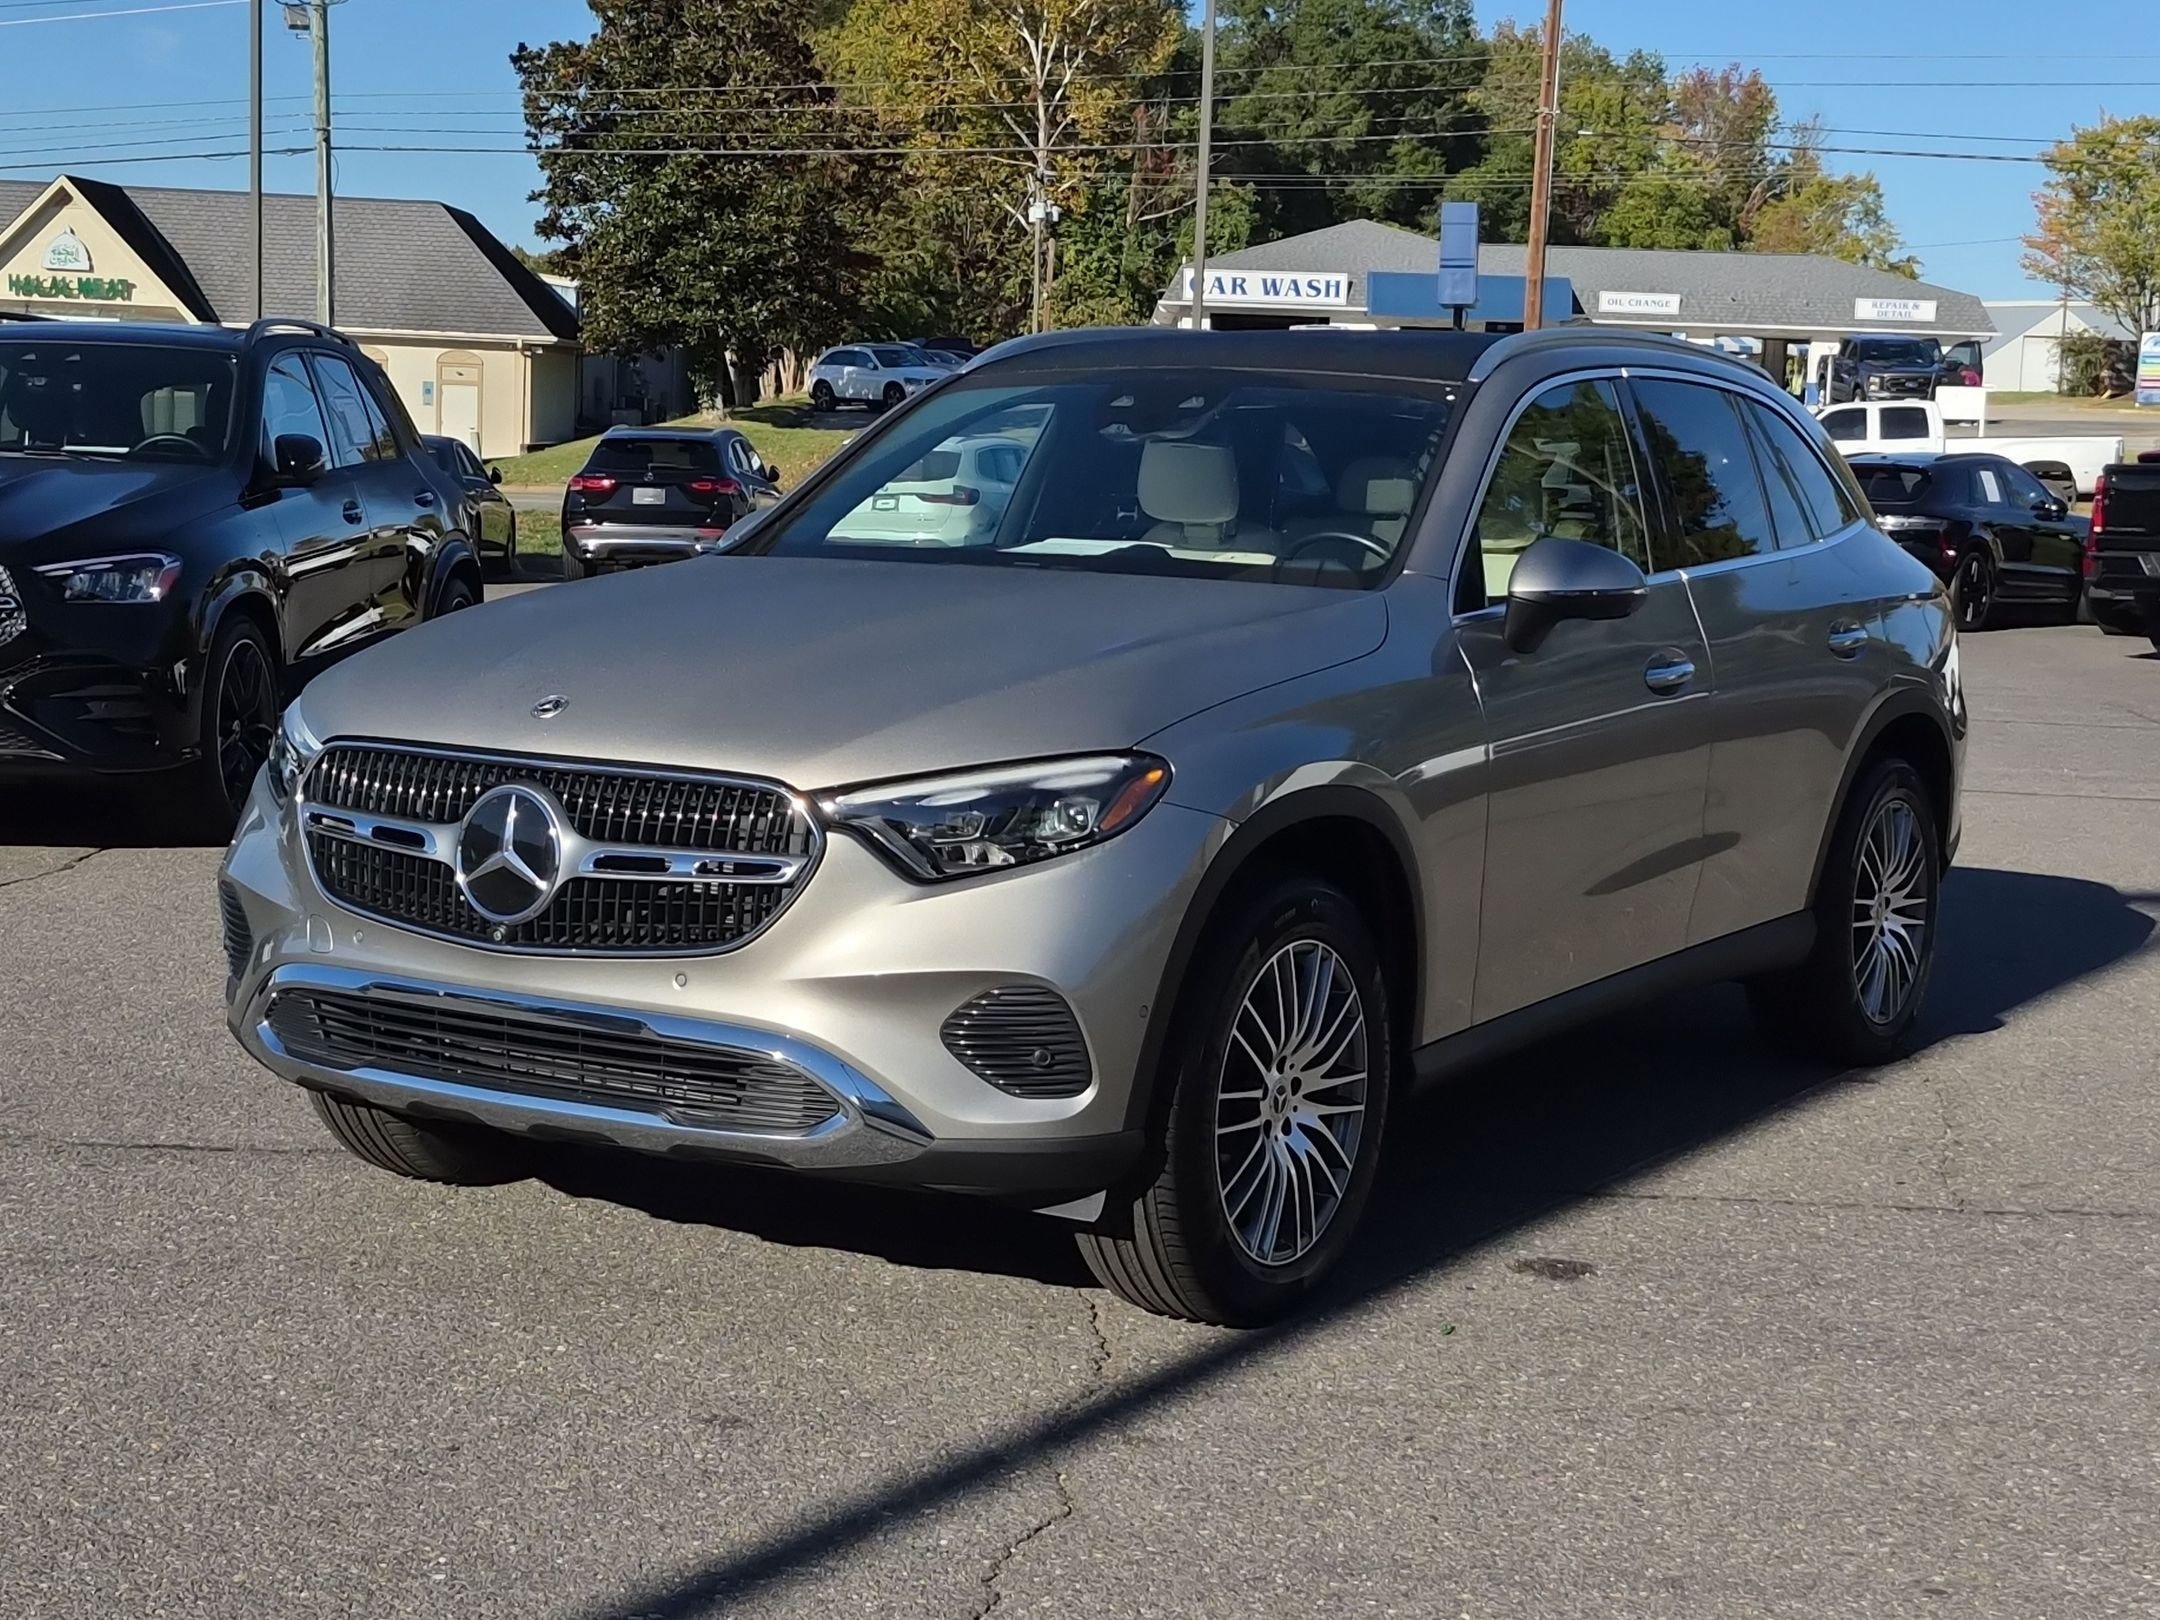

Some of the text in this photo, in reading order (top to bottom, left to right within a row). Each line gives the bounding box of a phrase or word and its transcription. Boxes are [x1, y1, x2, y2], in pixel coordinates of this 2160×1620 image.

[1261, 277, 1342, 298] WASH
[1607, 297, 1671, 308] OIL CHANGE
